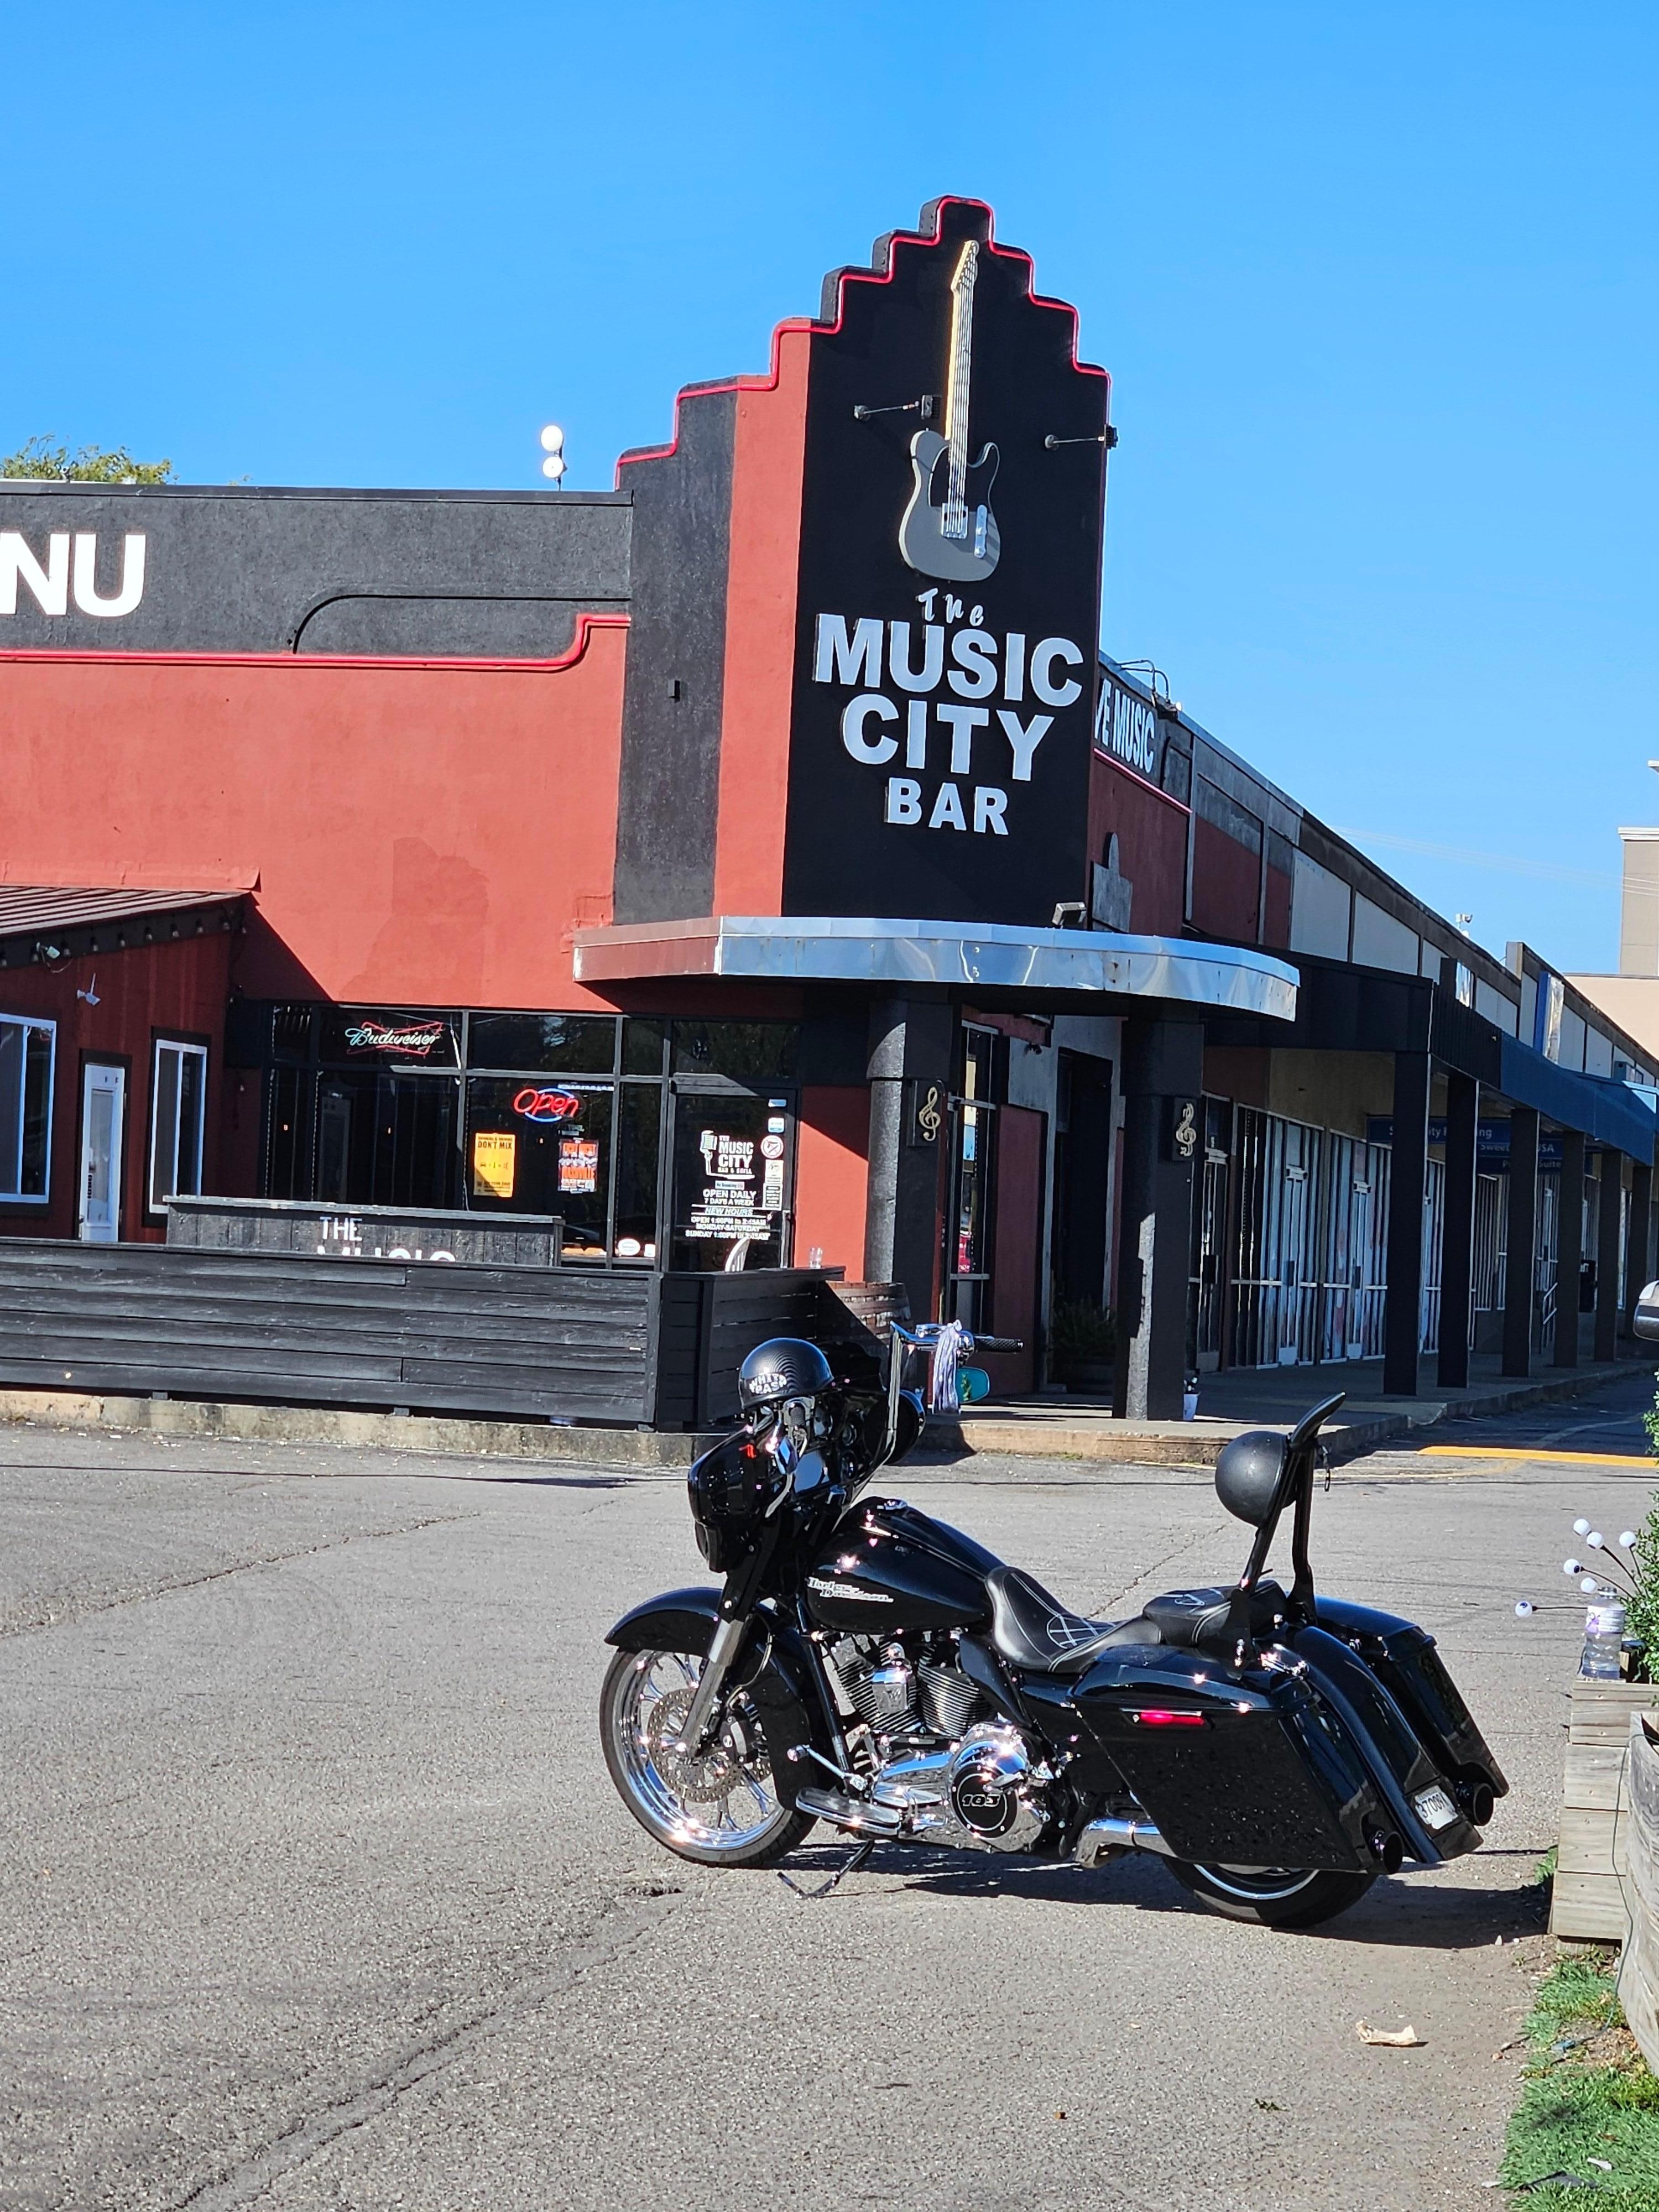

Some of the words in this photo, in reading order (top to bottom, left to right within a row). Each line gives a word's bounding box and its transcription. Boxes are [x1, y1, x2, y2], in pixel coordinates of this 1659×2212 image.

[0, 533, 146, 617] NU
[916, 588, 984, 627] The
[814, 613, 1083, 707] MUSIC
[842, 693, 1054, 781] CITY
[1113, 688, 1155, 774] MUSIC
[887, 778, 1009, 836] BAR
[345, 1028, 441, 1046] Budweiser
[514, 1088, 579, 1118] Open
[718, 1141, 754, 1155] MUSIC
[718, 1154, 753, 1168] CITY
[703, 1189, 728, 1198] OPEN
[730, 1191, 757, 1200] DAILY
[705, 1207, 724, 1215] NEW
[724, 1208, 754, 1216] HOURS
[320, 1216, 363, 1241] THE
[962, 1793, 1001, 1807] 103
